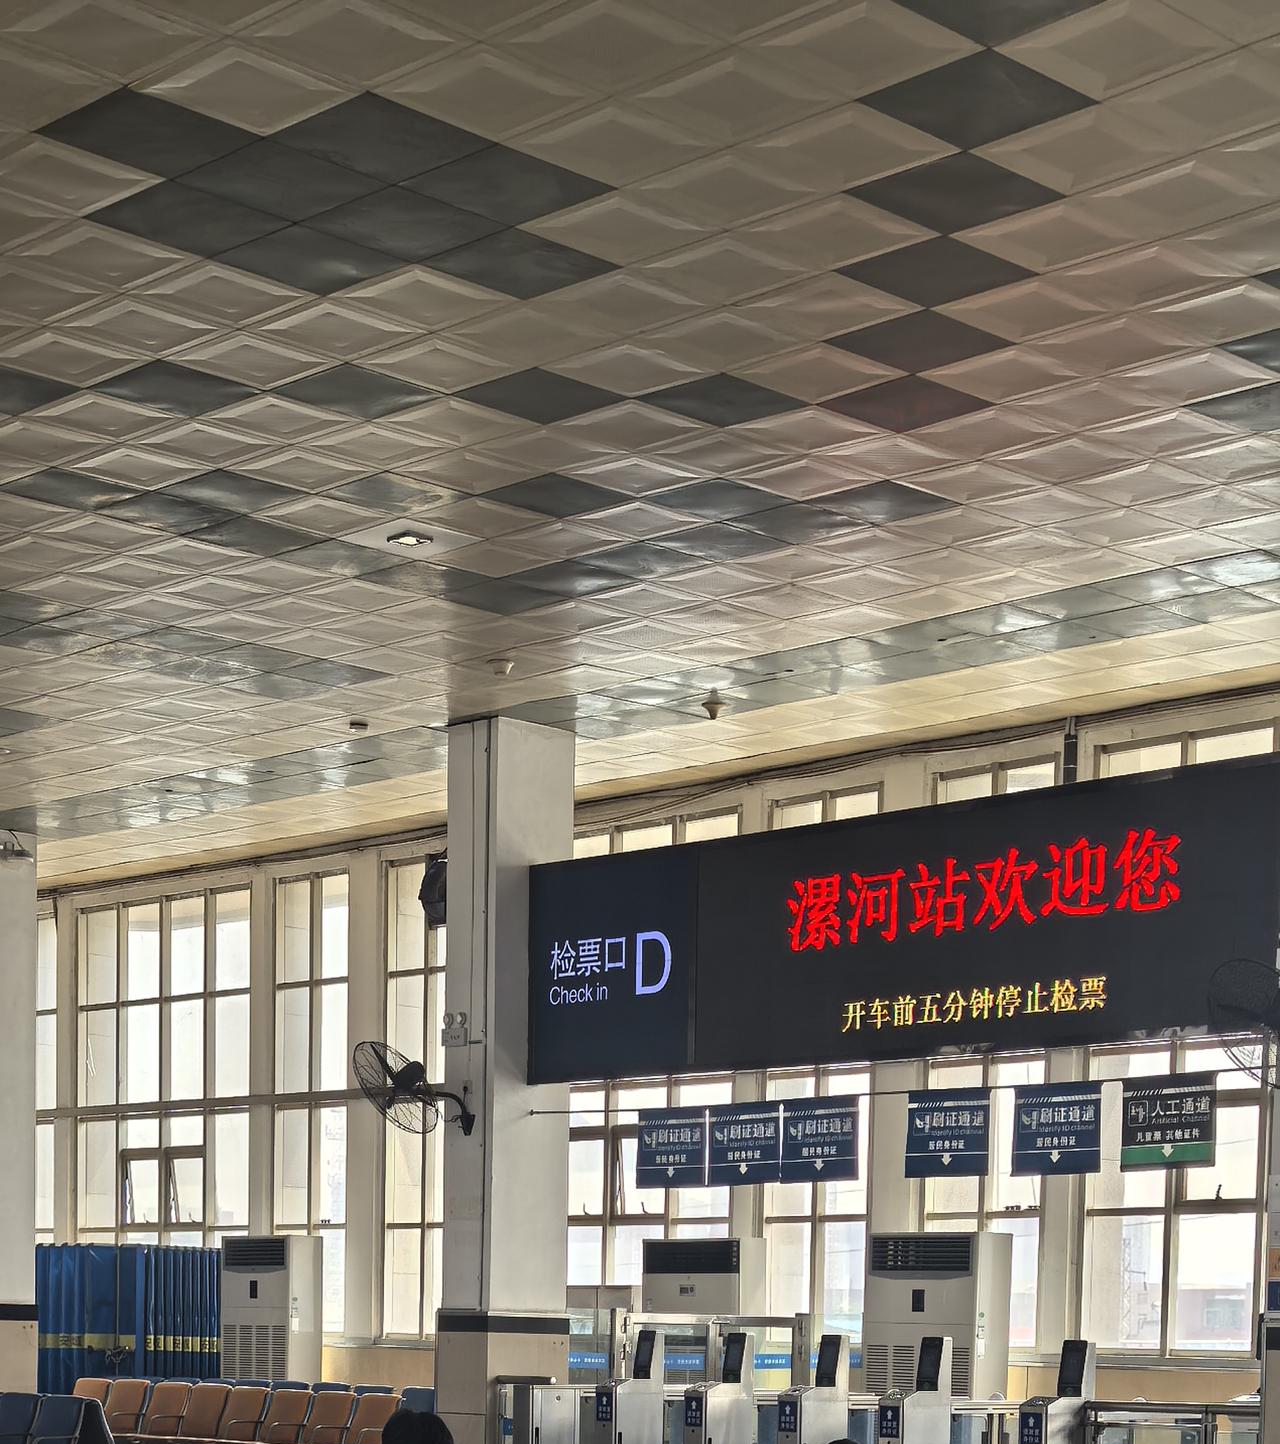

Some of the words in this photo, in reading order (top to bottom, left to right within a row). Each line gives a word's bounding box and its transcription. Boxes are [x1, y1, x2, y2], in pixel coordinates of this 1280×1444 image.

[786, 827, 1182, 952] 漯河站欢迎您
[550, 937, 626, 980] 检票口
[635, 930, 672, 996] D
[549, 983, 593, 1005] Check
[596, 982, 608, 1001] in
[841, 975, 1108, 1033] 开车前五分钟停止检票
[1040, 1104, 1096, 1124] 刷证通道
[1151, 1095, 1212, 1117] 人工通道
[804, 1116, 853, 1135] 刷证通道
[931, 1110, 985, 1128] 刷证通道
[657, 1127, 702, 1144] 刷证通道
[729, 1121, 776, 1139] 刷证通道
[1165, 1127, 1201, 1141] 其他证件
